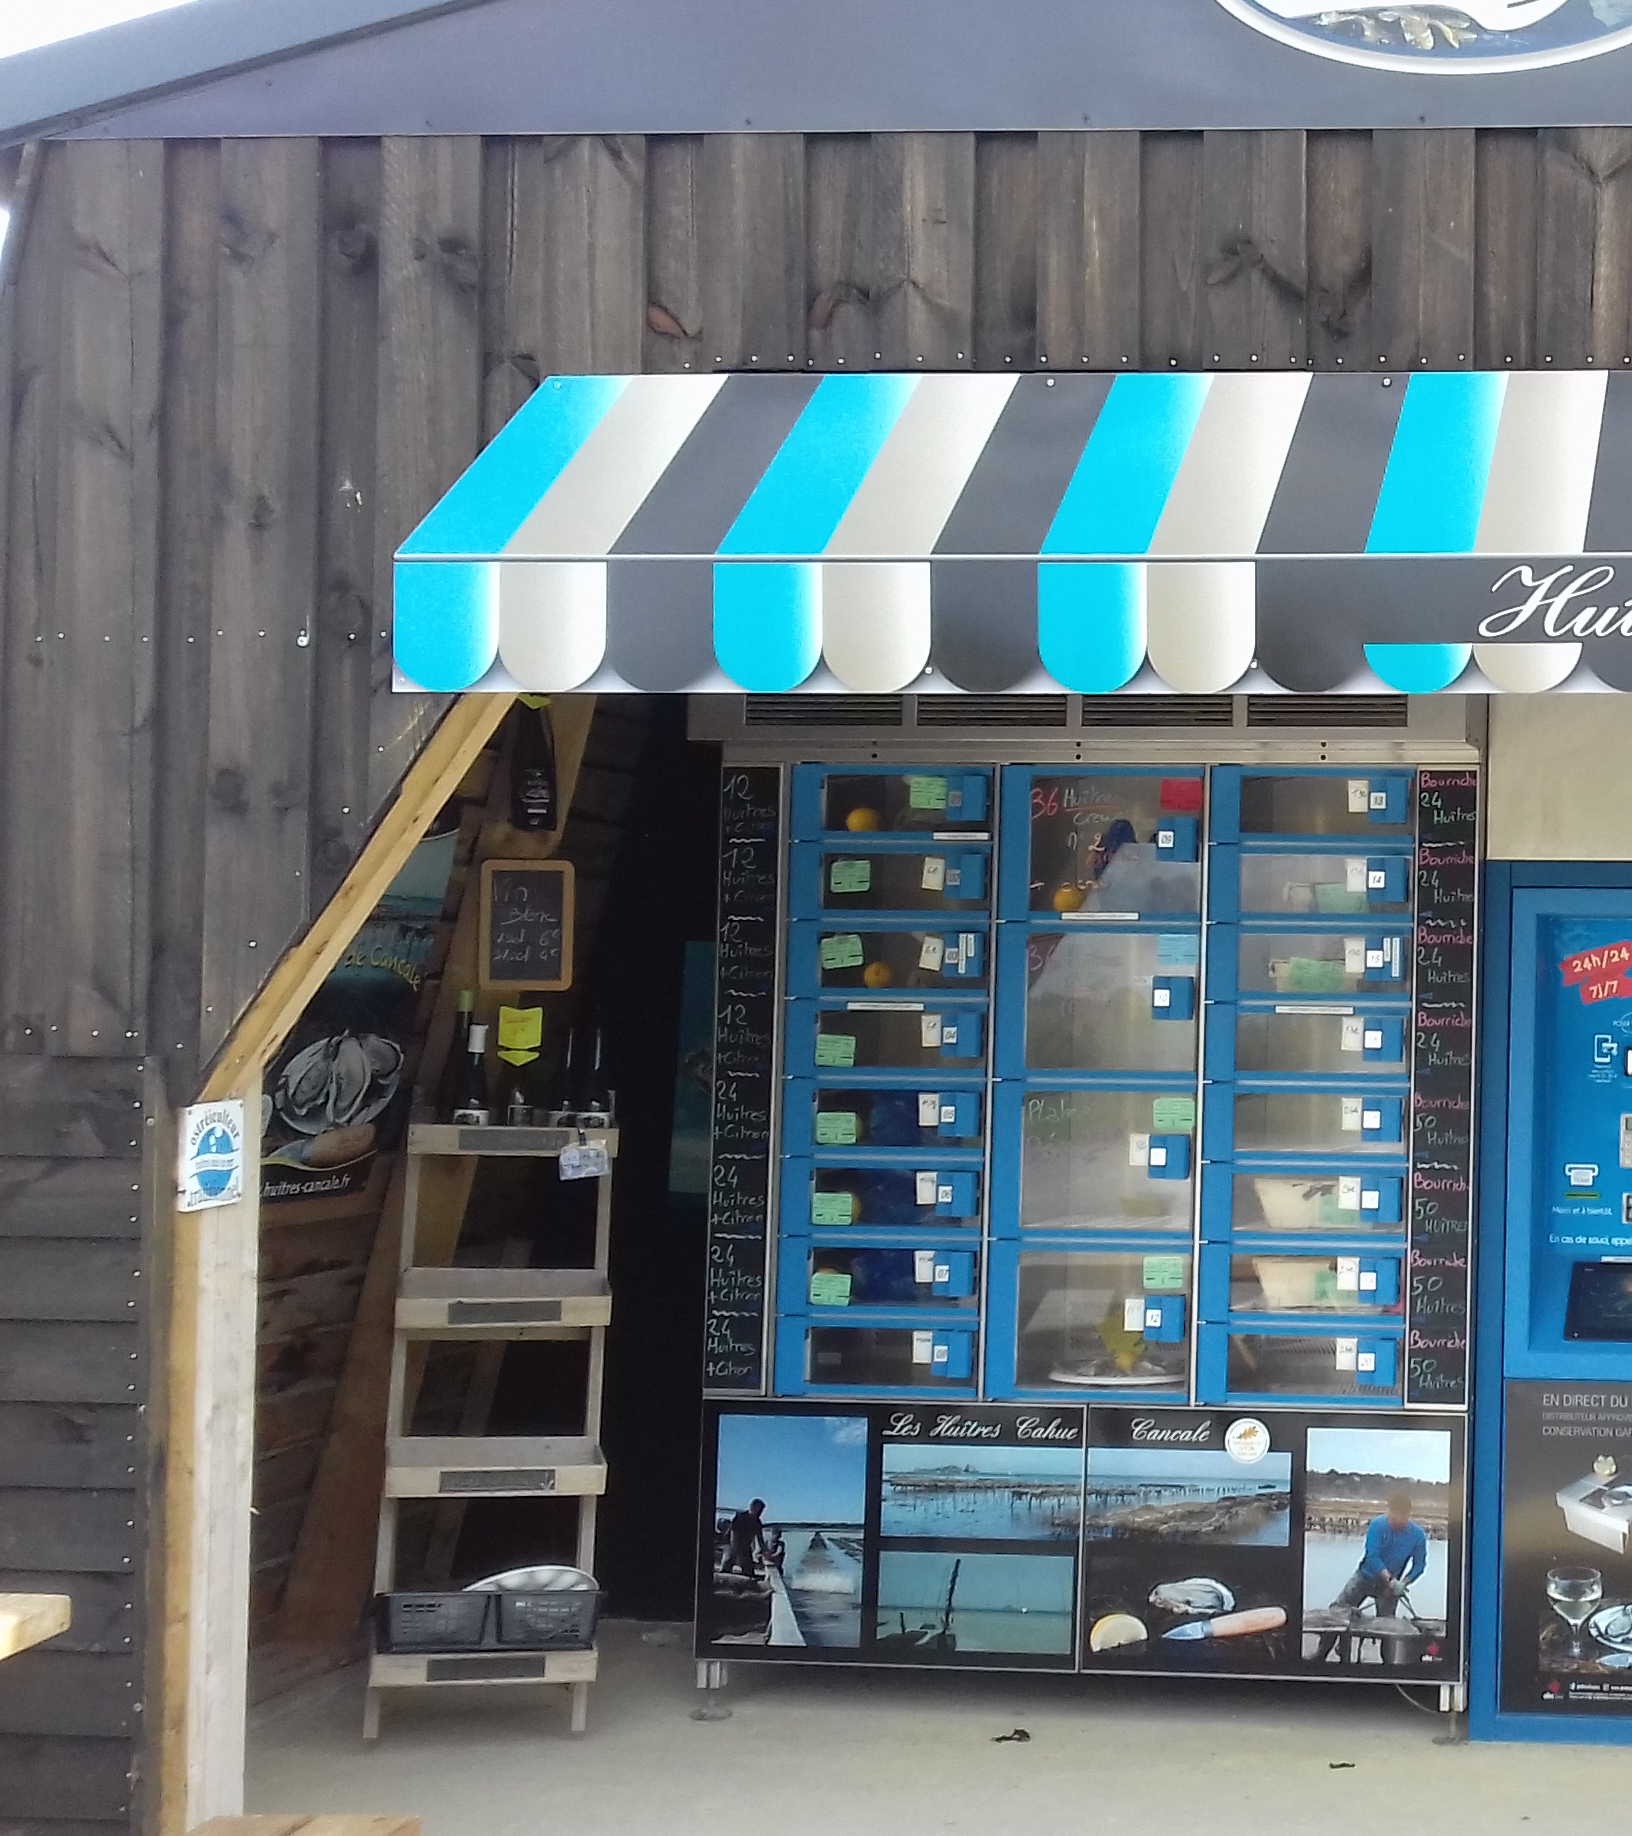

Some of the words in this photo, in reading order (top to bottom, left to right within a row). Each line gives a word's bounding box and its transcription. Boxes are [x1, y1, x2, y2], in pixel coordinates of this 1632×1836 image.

[1031, 787, 1059, 820] 36
[1420, 791, 1442, 809] 24
[1418, 870, 1440, 889] 24
[1417, 946, 1442, 966] 24
[1571, 946, 1631, 973] 24h/24
[1417, 1010, 1472, 1028] Bourriche
[1416, 1032, 1441, 1050] 24
[716, 1080, 738, 1102] 24
[1414, 1113, 1436, 1132] 50
[713, 1164, 739, 1188] 24
[1413, 1199, 1439, 1220] 50
[710, 1244, 735, 1268] 24
[1411, 1276, 1443, 1293] 50
[706, 1318, 732, 1339] 24
[1410, 1331, 1467, 1350] Bourriche
[1410, 1359, 1437, 1378] 50
[1543, 1393, 1560, 1407] EN
[1563, 1394, 1606, 1408] DIRECT
[1610, 1395, 1628, 1408] DU
[882, 1412, 921, 1437] Les
[929, 1414, 1002, 1439] Huîtres
[1015, 1416, 1080, 1441] Cahue
[1131, 1417, 1211, 1442] Cancale
[1542, 1426, 1613, 1437] CONSERVATION
